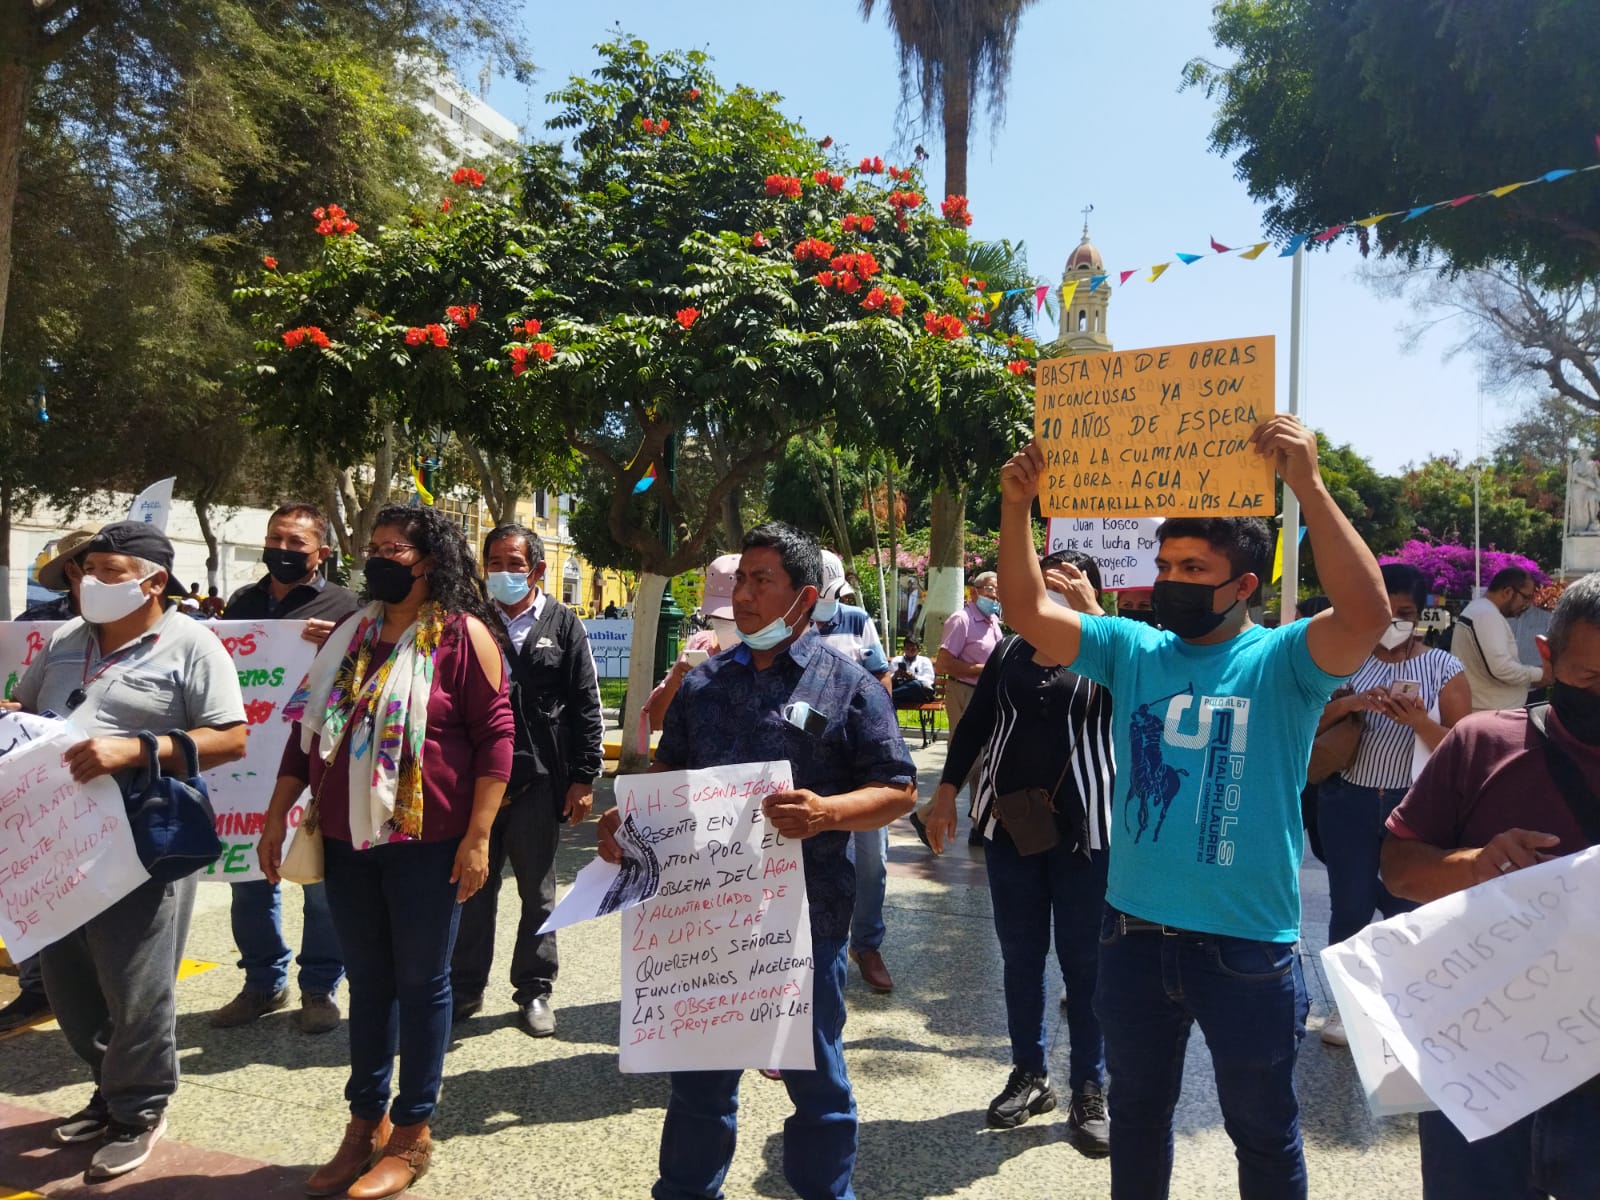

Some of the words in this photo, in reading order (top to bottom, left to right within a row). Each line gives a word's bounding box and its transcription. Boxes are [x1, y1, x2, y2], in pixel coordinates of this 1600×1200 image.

[1041, 359, 1090, 387] BASTA
[1101, 356, 1123, 384] YA
[1135, 352, 1170, 373] DE
[1189, 345, 1256, 369] OBRAS
[1043, 386, 1136, 411] INCONCLUSAS
[1160, 383, 1180, 406] YA
[1199, 376, 1245, 398] SON
[1042, 417, 1062, 440] 10
[1072, 411, 1111, 438] AÑOS
[1128, 415, 1160, 437] DE
[1177, 405, 1257, 435] ESPERA
[1047, 449, 1079, 468] PARA
[1090, 448, 1109, 465] LA
[1048, 474, 1066, 489] DE
[1131, 469, 1181, 489] AGUA
[1199, 469, 1210, 493] Y
[1188, 493, 1220, 511] UPIS
[1228, 491, 1265, 509] LAE
[1073, 518, 1094, 531] Juan
[587, 630, 628, 641] ubilar
[1213, 755, 1228, 803] RALPH
[58, 815, 69, 840] A
[73, 796, 98, 820] LA
[641, 818, 697, 845] RESENTE
[706, 815, 735, 832] EN
[752, 808, 765, 824] E
[1217, 754, 1245, 866] POLS
[1206, 805, 1223, 865] LAUREN
[659, 850, 700, 873] NTON
[707, 839, 744, 865] POR
[658, 878, 711, 898] OBLEMA
[716, 864, 758, 888] DEL
[763, 856, 798, 880] AGUA
[14, 909, 40, 942] DE
[41, 866, 88, 912] PIURA
[634, 910, 647, 936] Y
[762, 886, 788, 903] DE
[632, 928, 658, 951] LA
[632, 1003, 665, 1025] LAS
[630, 1026, 665, 1045] DEL
